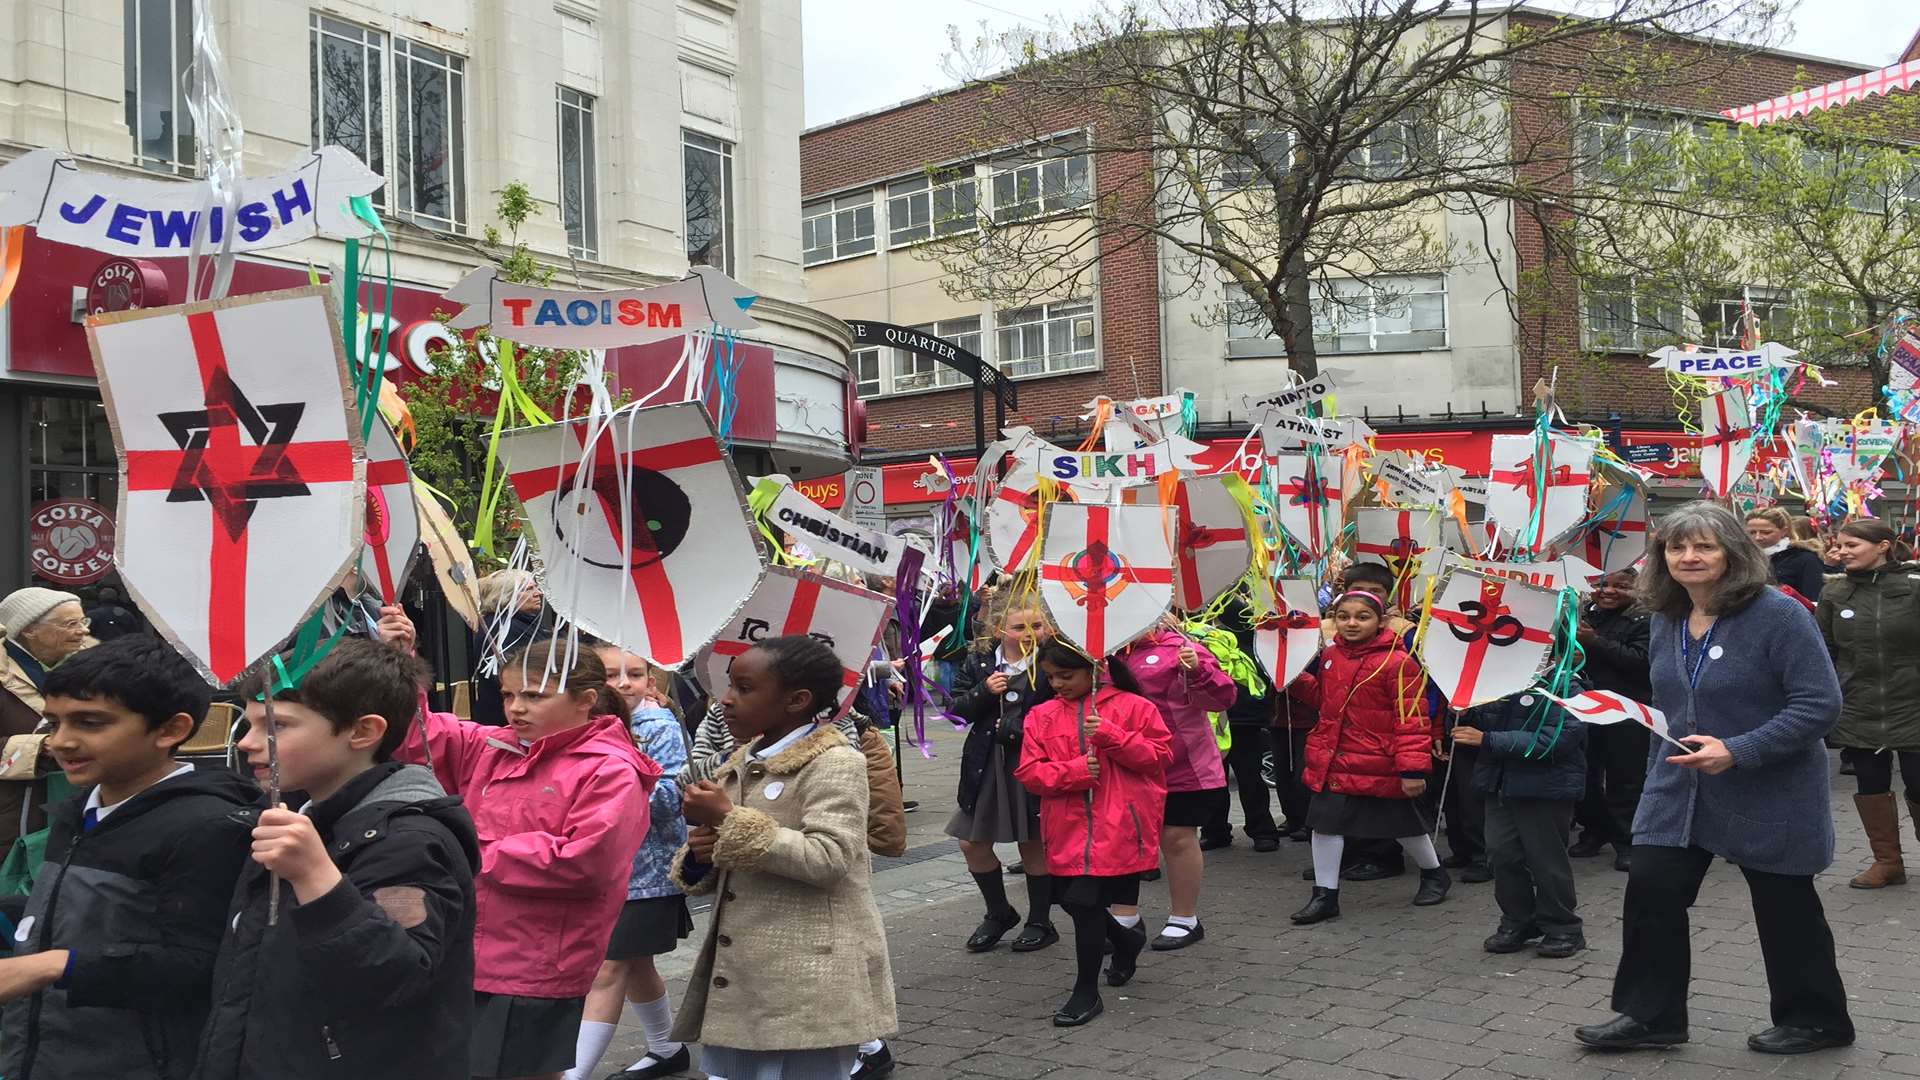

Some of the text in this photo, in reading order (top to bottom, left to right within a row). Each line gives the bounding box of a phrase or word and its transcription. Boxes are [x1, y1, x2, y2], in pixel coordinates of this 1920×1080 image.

[59, 178, 312, 248] JEWISH
[97, 264, 135, 287] COSTA
[503, 298, 682, 329] TAOISM
[885, 328, 956, 361] QUARTER
[1680, 355, 1762, 373] PEACE
[1053, 453, 1156, 479] SIKH
[799, 481, 839, 503] buys
[38, 506, 104, 528] COSTA
[32, 548, 112, 576] COFFEE
